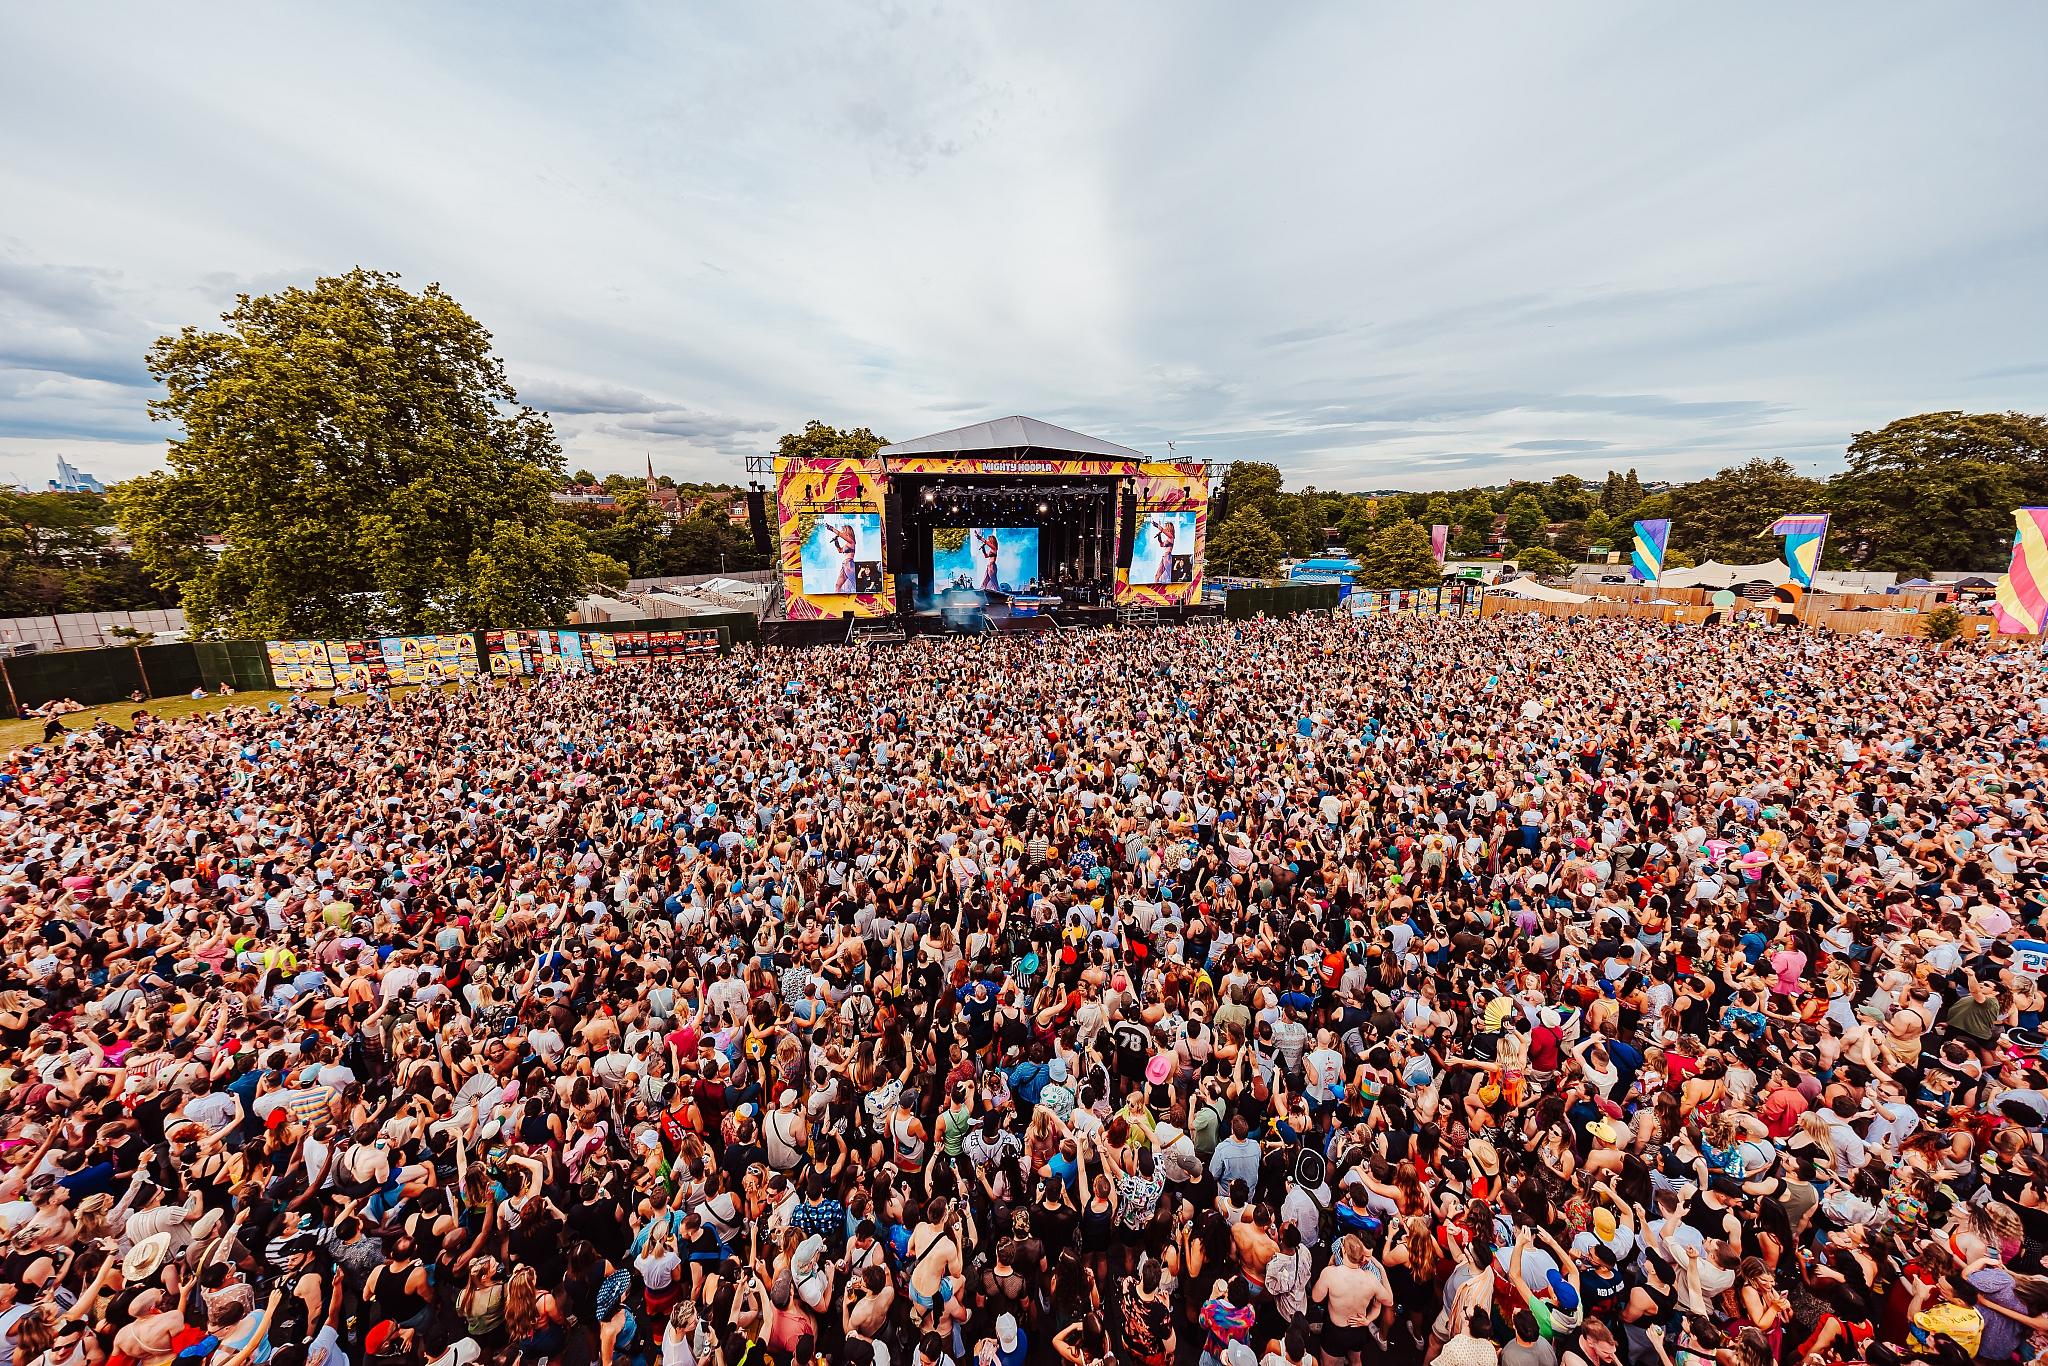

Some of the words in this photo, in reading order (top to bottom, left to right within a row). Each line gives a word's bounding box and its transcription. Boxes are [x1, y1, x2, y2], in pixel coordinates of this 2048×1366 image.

[982, 463, 1016, 471] MIGHTY
[1018, 463, 1051, 471] HOOPLA
[1118, 1031, 1142, 1052] 78
